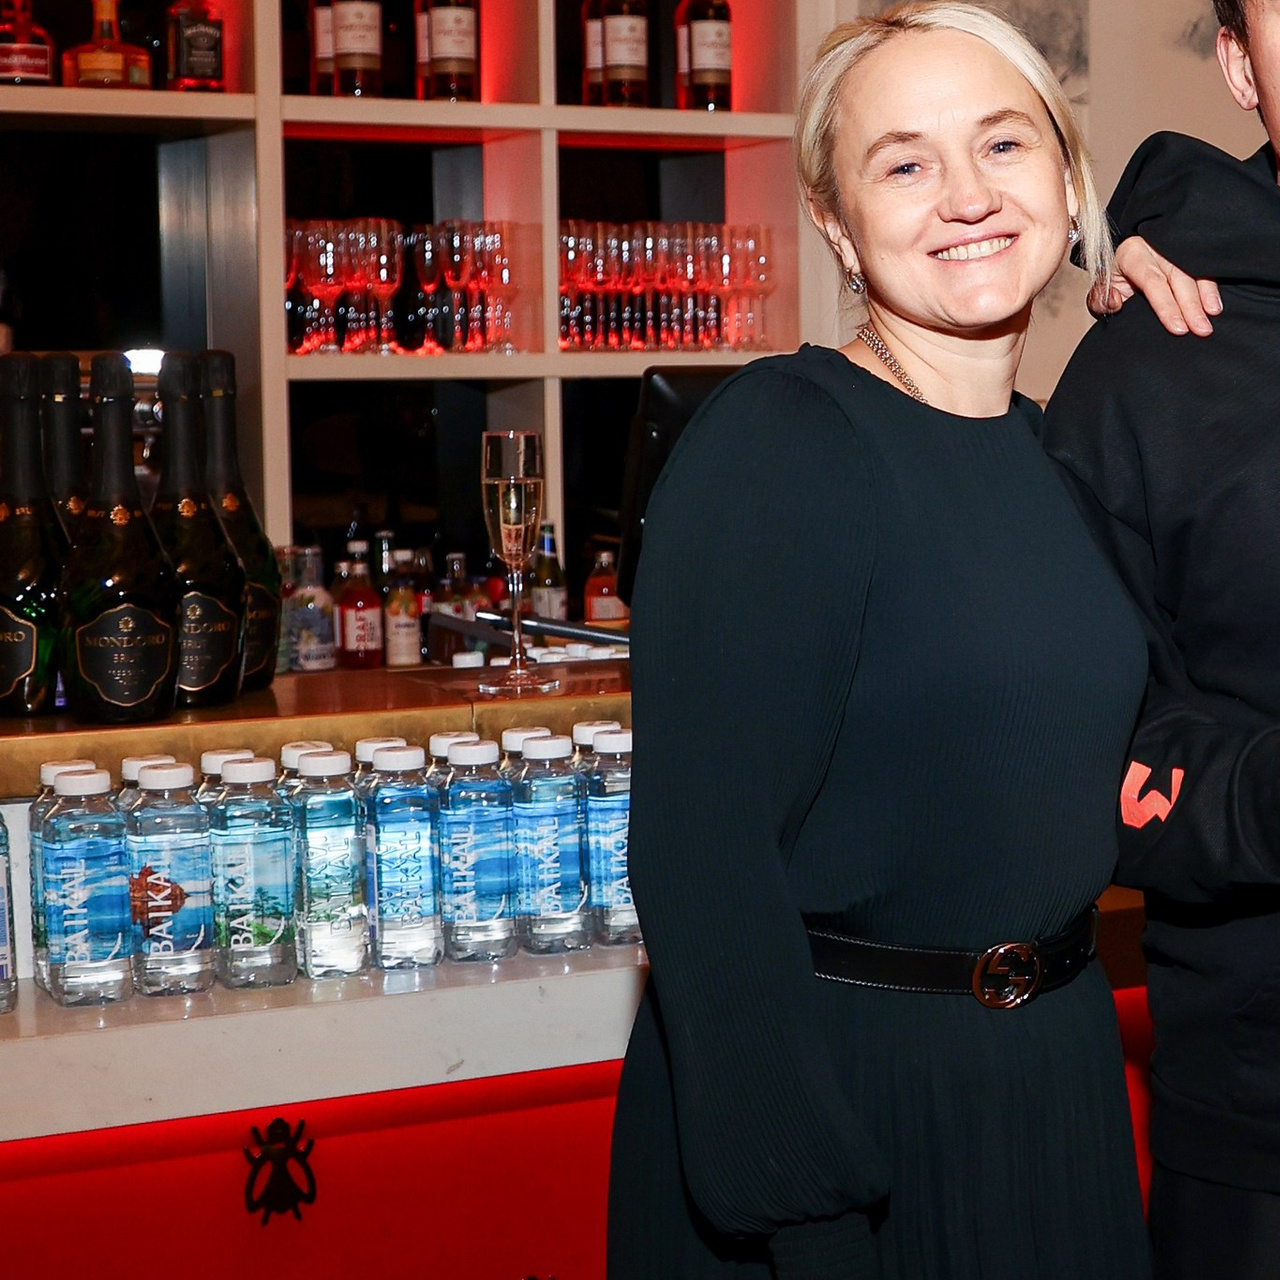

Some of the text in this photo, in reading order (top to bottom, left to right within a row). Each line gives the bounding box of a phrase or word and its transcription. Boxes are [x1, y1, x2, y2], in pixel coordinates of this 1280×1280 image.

[84, 633, 166, 649] MONDORO
[61, 859, 90, 966] BAIKAL
[147, 851, 173, 957] BAIKAL
[228, 845, 253, 950] BAIKAL
[450, 824, 478, 926] BAIKAL
[537, 817, 563, 917] BAIKAL
